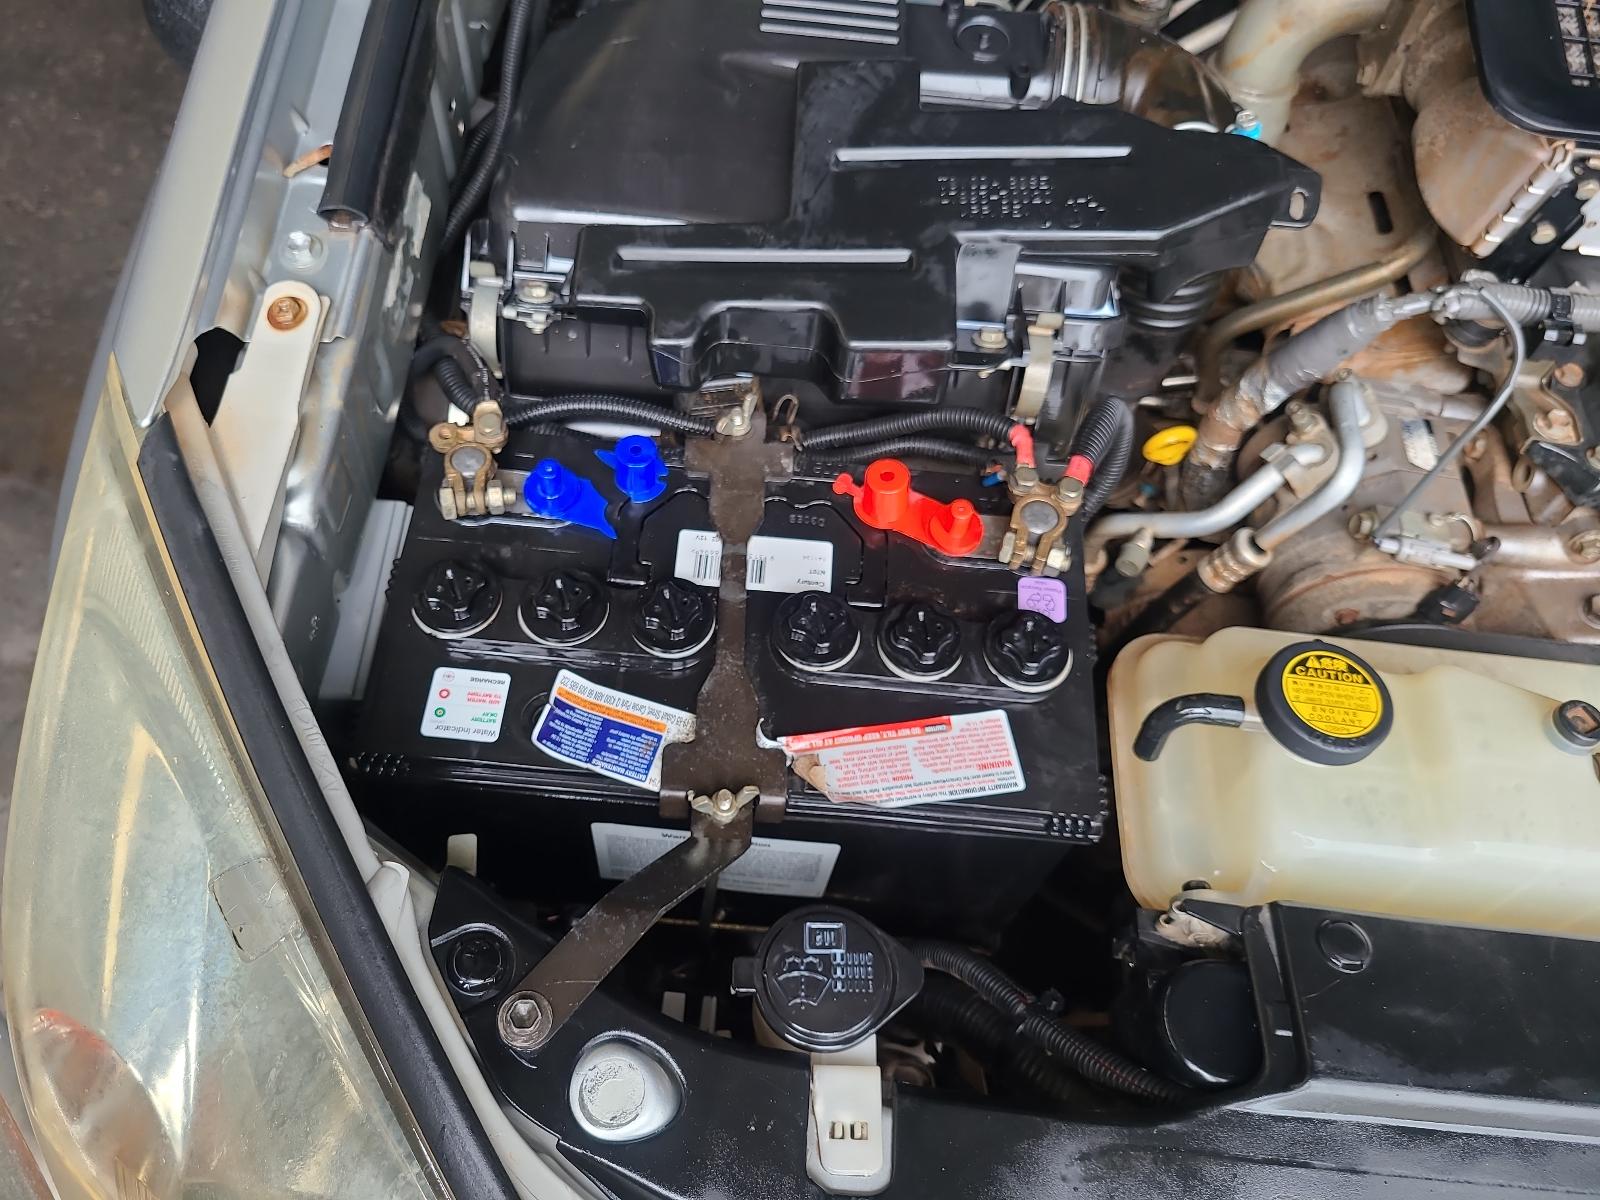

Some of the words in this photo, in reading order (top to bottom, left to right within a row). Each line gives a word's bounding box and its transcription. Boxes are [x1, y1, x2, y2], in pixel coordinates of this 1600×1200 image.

[797, 579, 825, 588] Century
[1295, 665, 1364, 684] CAUTION
[470, 677, 505, 685] RECHARGE
[1311, 705, 1359, 718] ENGINE
[1309, 712, 1362, 724] COOLANT
[435, 725, 470, 735] Indicator
[473, 729, 496, 737] Water
[591, 759, 626, 775] MAINTENANCE
[975, 760, 1013, 771] WARNING
[625, 766, 646, 781] BATTERY
[892, 775, 913, 783] POISON
[947, 785, 986, 796] INFORMATION
[987, 781, 1019, 791] WARRANTY
